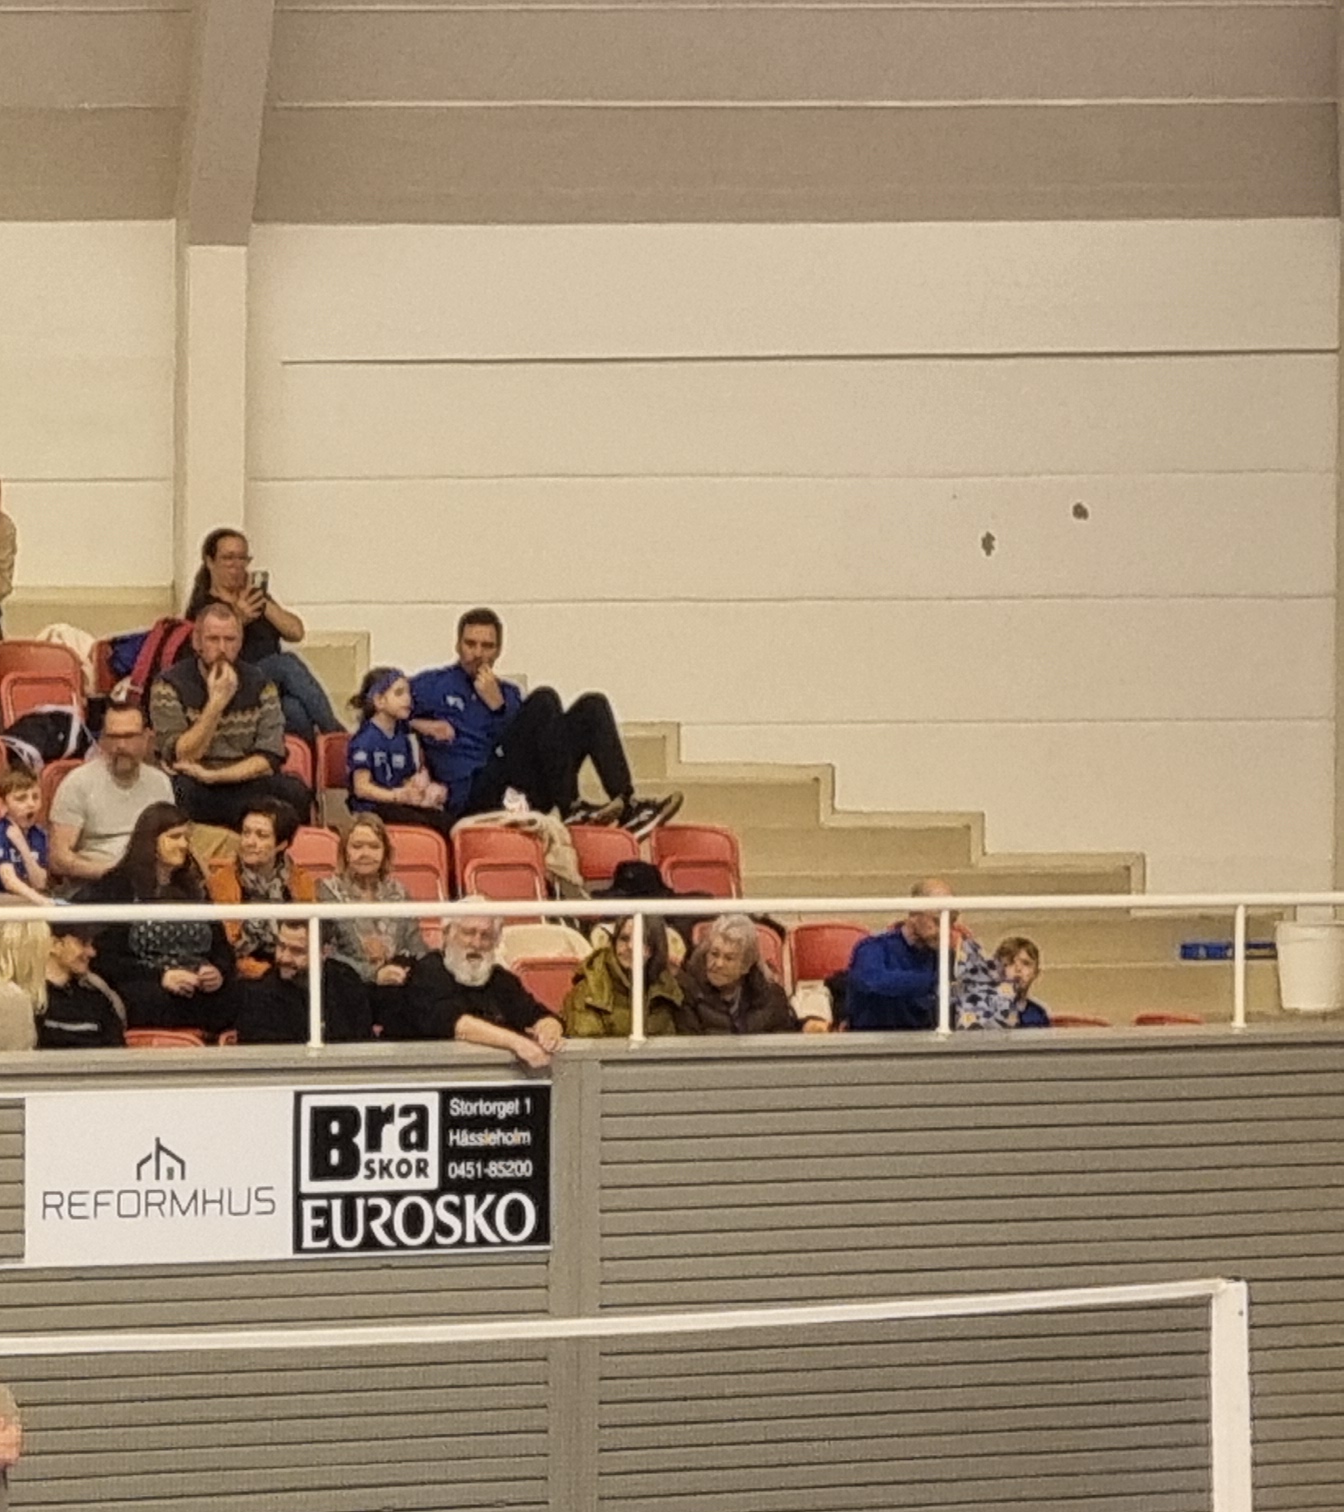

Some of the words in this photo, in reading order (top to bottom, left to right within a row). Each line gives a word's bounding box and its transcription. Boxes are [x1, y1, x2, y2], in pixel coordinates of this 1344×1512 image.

[449, 1097, 520, 1120] Stortorget
[524, 1097, 531, 1115] 1
[308, 1102, 430, 1182] Bra
[363, 1157, 430, 1181] SKOR
[447, 1159, 533, 1180] 0451-85200
[41, 1185, 277, 1221] REFORMHUS
[301, 1192, 537, 1249] EUROSKO
